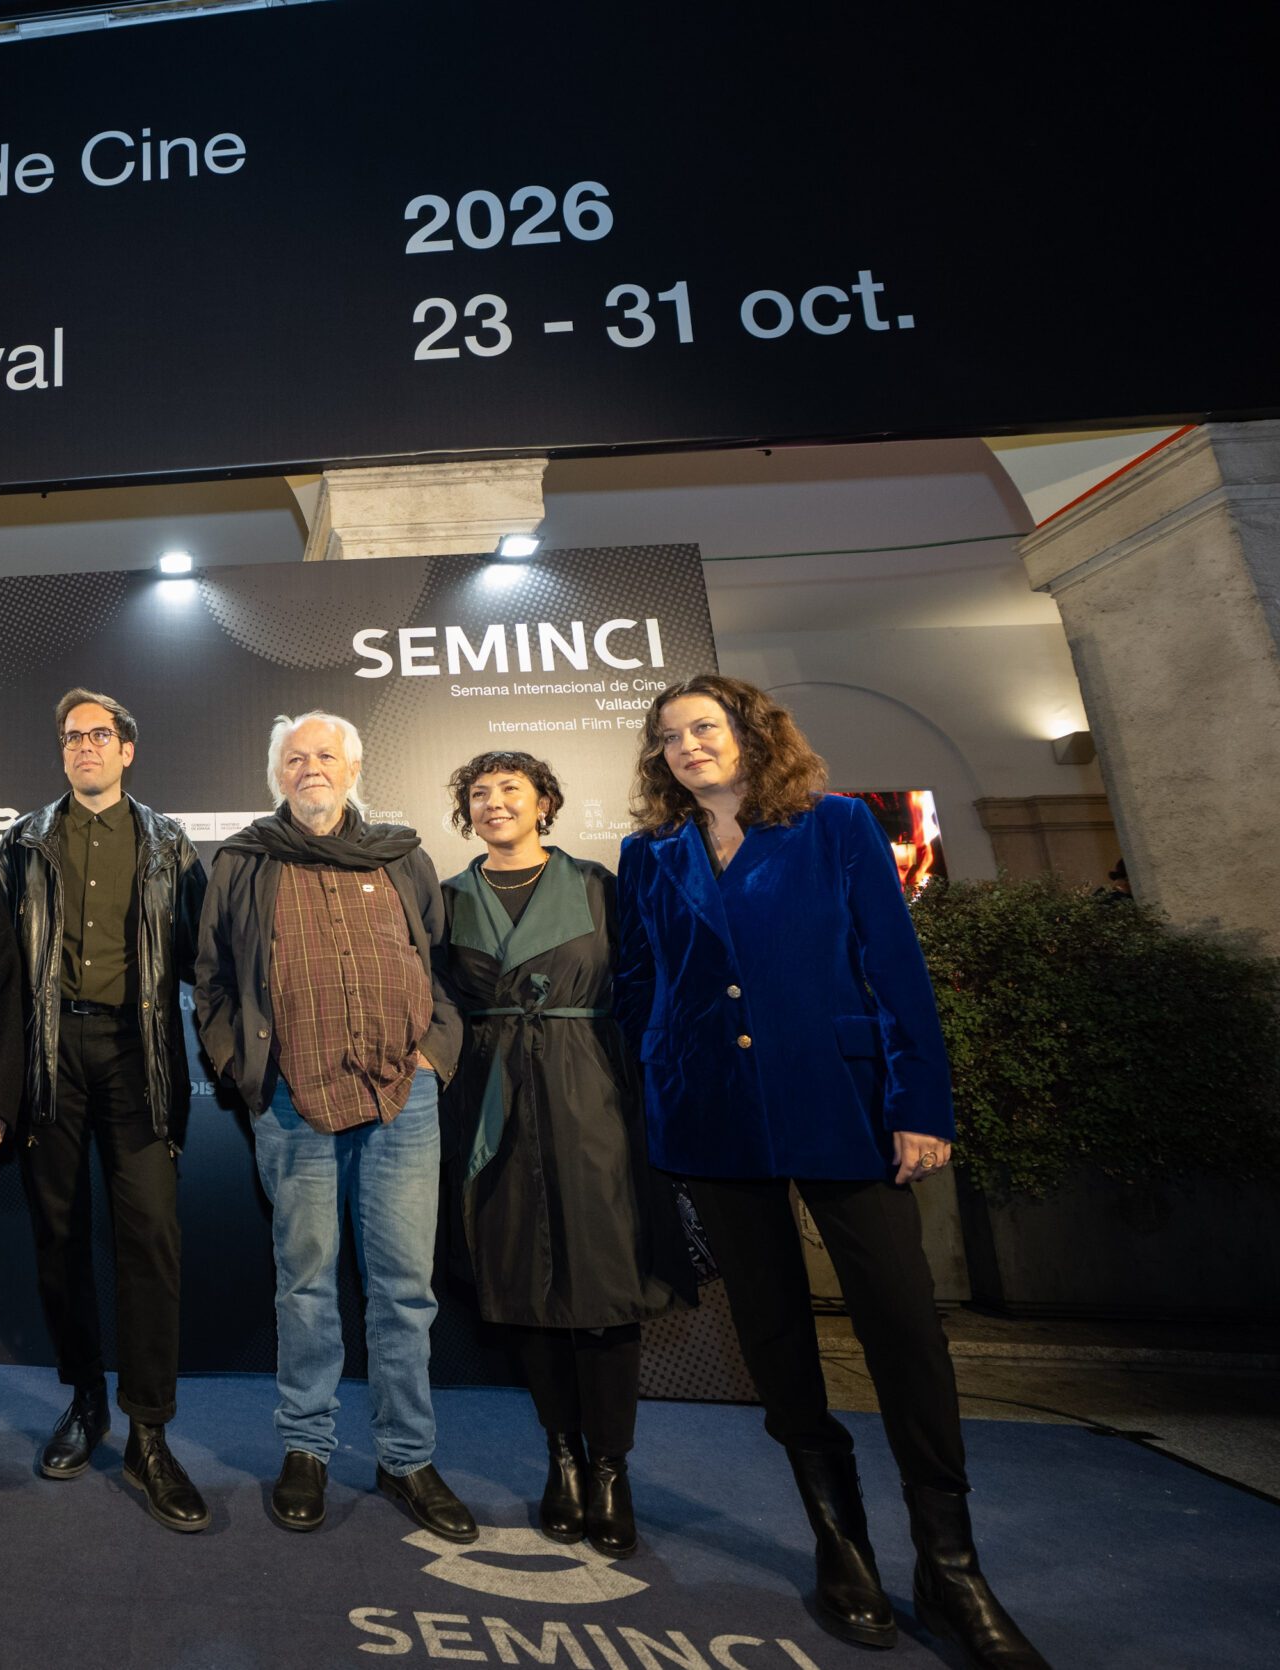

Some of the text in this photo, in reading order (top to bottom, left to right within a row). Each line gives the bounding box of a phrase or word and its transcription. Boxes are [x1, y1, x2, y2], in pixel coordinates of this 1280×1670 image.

[80, 127, 247, 187] Cine
[404, 180, 614, 255] 2026
[412, 269, 915, 361] 23 - 31 oct.
[352, 618, 665, 679] SEMINCI
[450, 679, 667, 697] Semana Internacional de Cine
[488, 718, 577, 733] International
[581, 717, 613, 730] Film
[369, 809, 403, 820] Europa
[579, 831, 618, 840] Castilla
